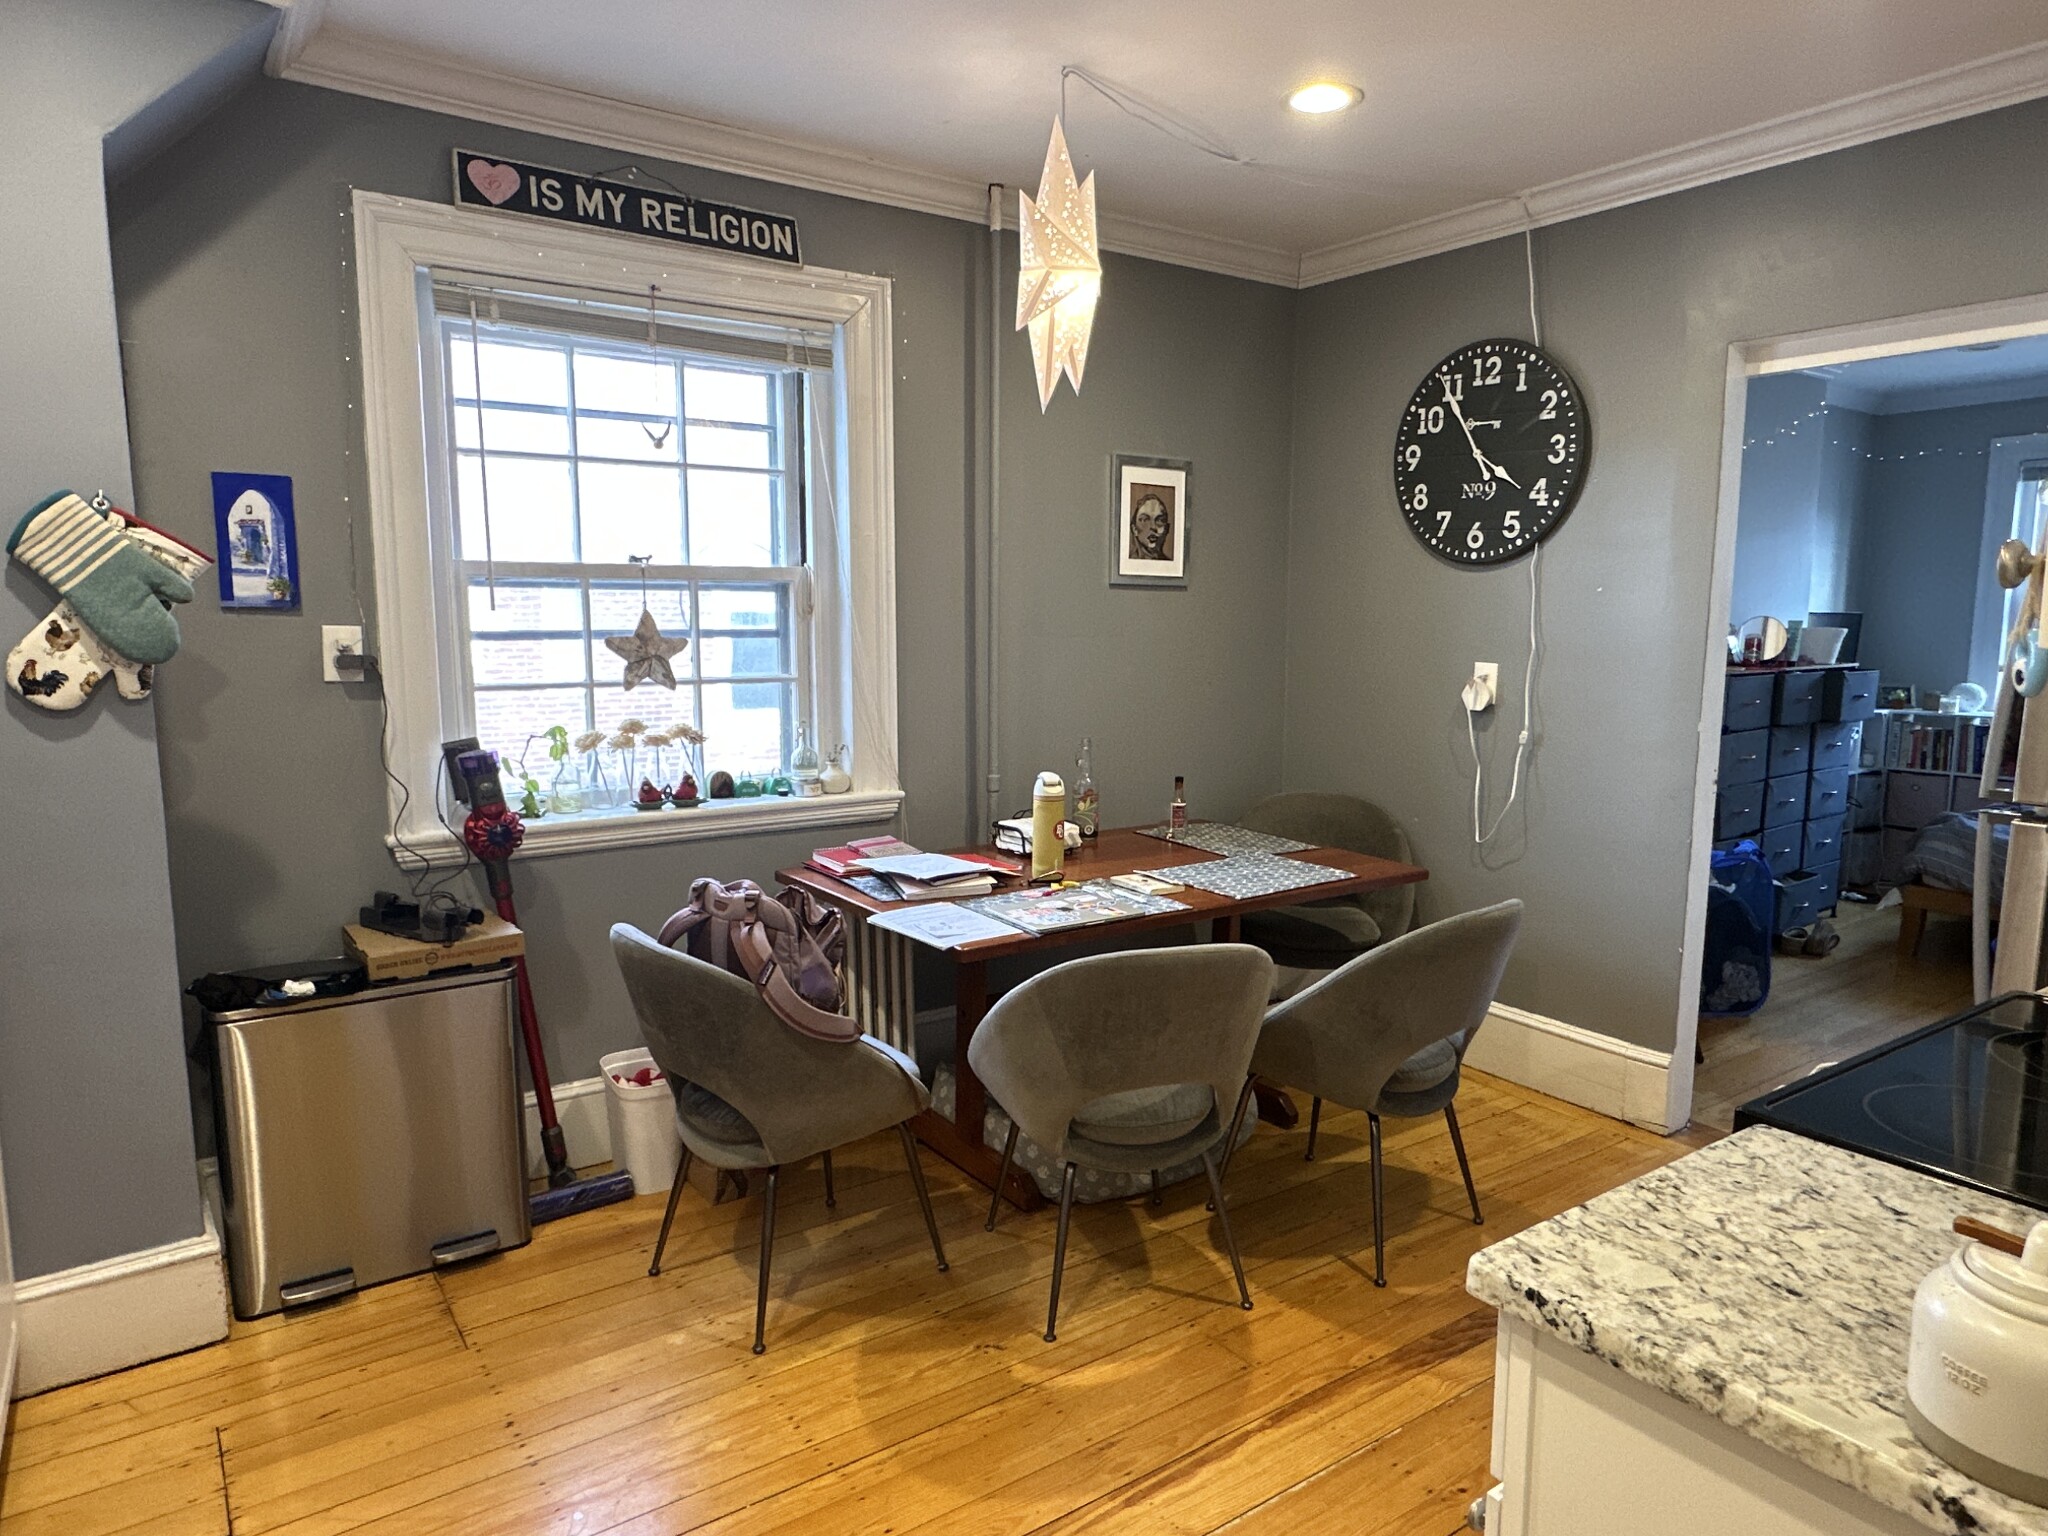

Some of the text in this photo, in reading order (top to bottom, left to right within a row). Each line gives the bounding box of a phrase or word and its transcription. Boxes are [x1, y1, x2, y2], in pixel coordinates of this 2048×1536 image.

[529, 174, 794, 255] IS MY RELIGION
[1472, 355, 1502, 387] 12
[1516, 363, 1527, 392] 1
[1442, 373, 1464, 402] 11
[1416, 405, 1444, 434] 10
[1539, 390, 1558, 420] 2
[1405, 445, 1421, 471] 9
[1547, 433, 1566, 464] 3
[1413, 484, 1428, 511] 8
[1528, 478, 1550, 506] 4
[1436, 511, 1452, 537] 7
[1466, 522, 1484, 549] 6
[1502, 510, 1521, 539] 5
